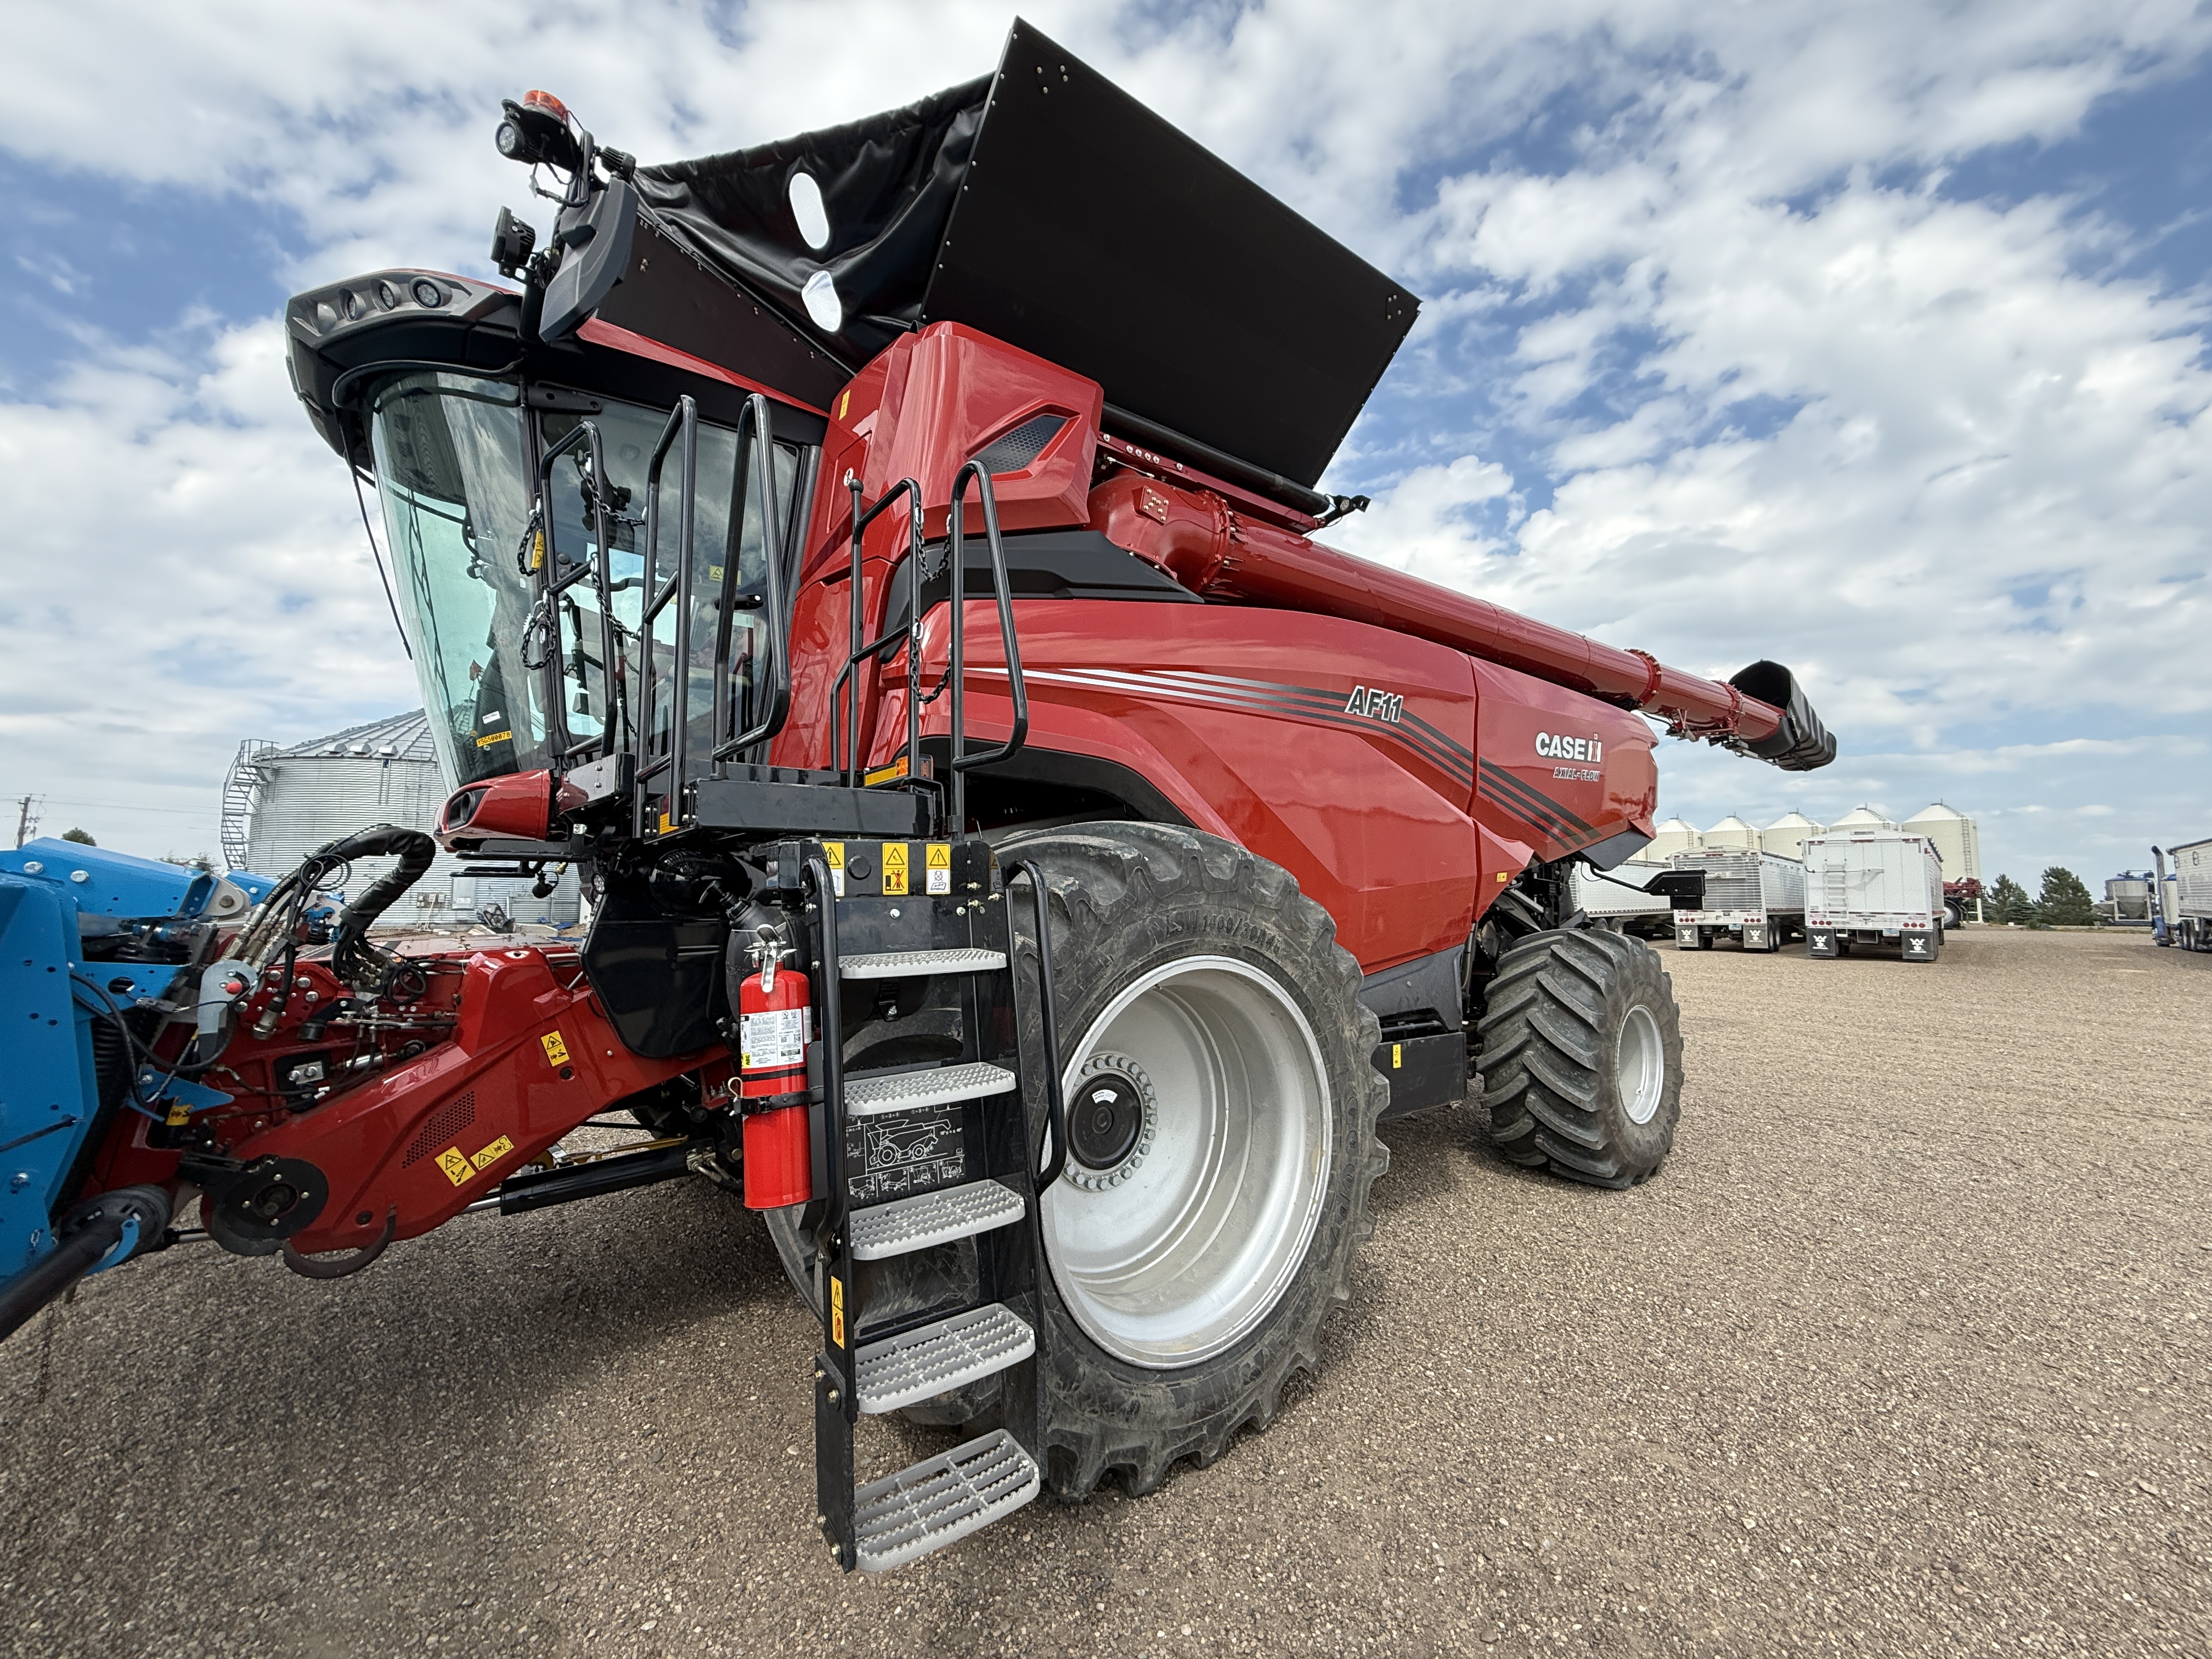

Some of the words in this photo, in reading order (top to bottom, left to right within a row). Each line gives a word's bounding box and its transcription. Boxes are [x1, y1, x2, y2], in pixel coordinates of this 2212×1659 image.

[1344, 685, 1403, 723] AF11
[1536, 732, 1585, 760] CASE
[1553, 767, 1600, 781] AXIAL-FLOW
[1166, 910, 1198, 939] LSW
